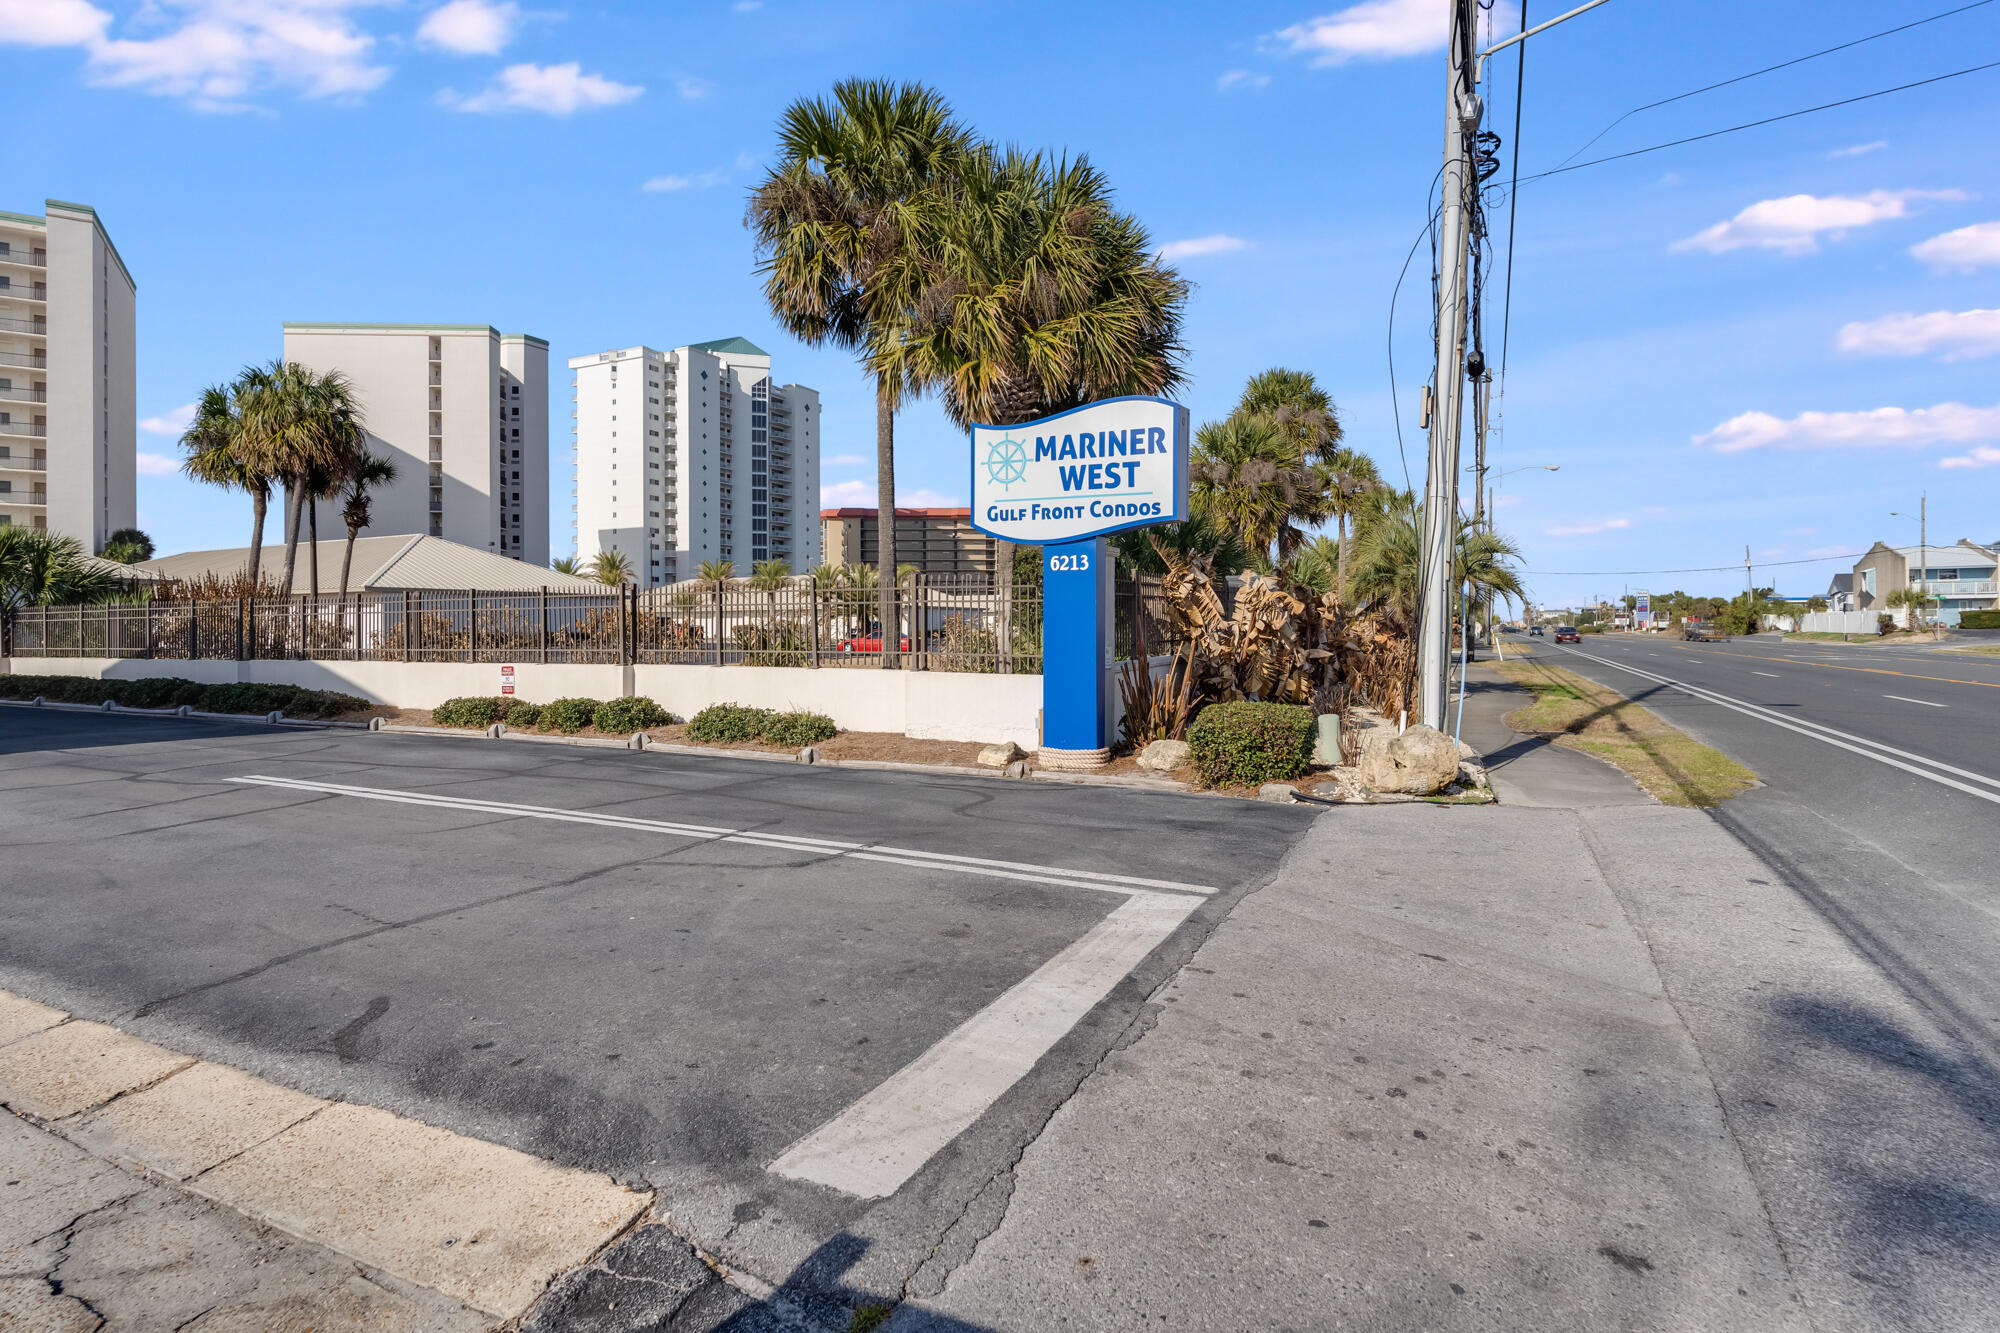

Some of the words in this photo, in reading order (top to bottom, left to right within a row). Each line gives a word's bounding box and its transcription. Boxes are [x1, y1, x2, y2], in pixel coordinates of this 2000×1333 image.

[1035, 427, 1167, 462] MARINER
[1059, 461, 1141, 491] WEST
[1050, 554, 1089, 572] 6213
